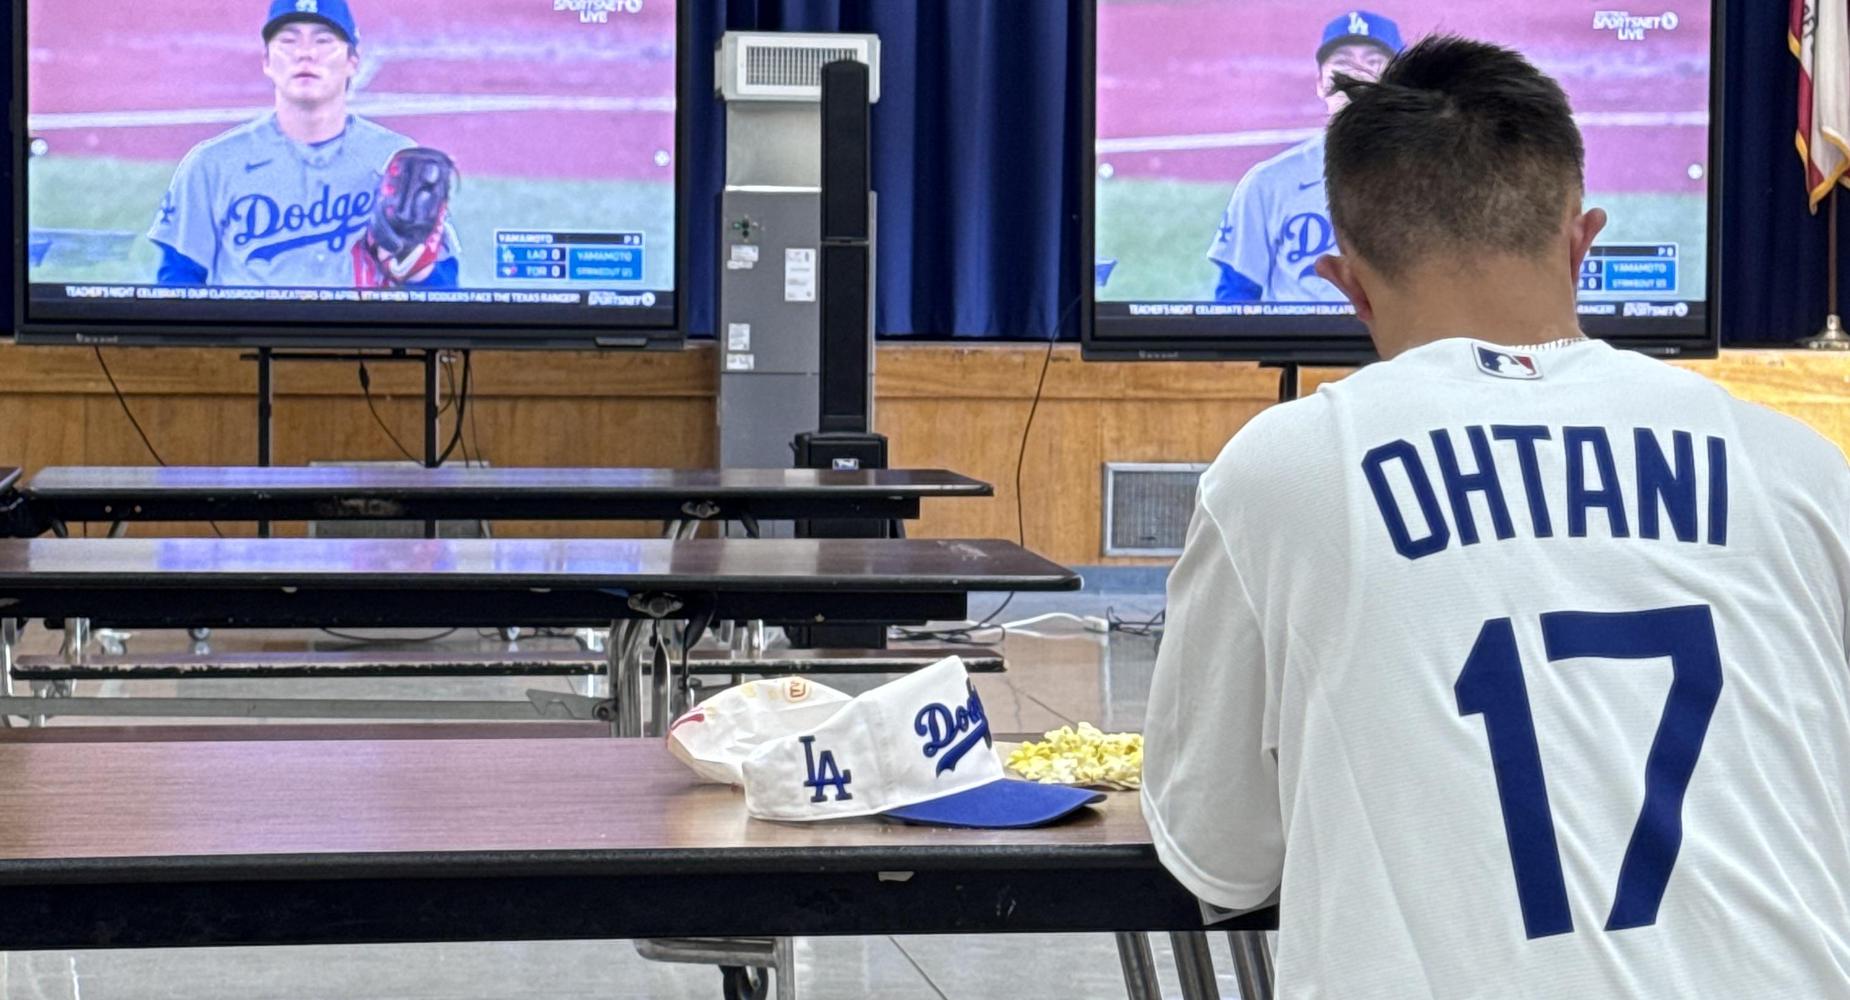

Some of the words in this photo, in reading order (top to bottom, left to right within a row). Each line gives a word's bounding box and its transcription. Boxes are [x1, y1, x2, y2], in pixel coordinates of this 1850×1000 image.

[579, 11, 608, 24] LIVE
[1617, 28, 1645, 41] LIVE
[498, 233, 554, 244] YAMAMOTO
[551, 248, 561, 261] 0
[576, 250, 633, 263] YAMAMOTO
[551, 265, 561, 278] 0
[1588, 260, 1597, 273] 0
[1612, 262, 1667, 274] YAMAMOTO
[1588, 277, 1597, 289] 0
[136, 287, 187, 300] CELEBRATE
[188, 288, 208, 300] OUR
[209, 288, 265, 301] CLASSROOM
[265, 289, 319, 301] EDUCATORS
[319, 290, 334, 301] ON
[335, 290, 360, 302] APRIL
[381, 290, 410, 302] WHEN
[410, 291, 427, 303] THE
[428, 291, 470, 303] DODGERS
[470, 292, 492, 304] FACE
[493, 292, 511, 304] THE
[511, 292, 540, 304] TEXAS
[1195, 304, 1242, 315] CELEBRATE
[1243, 304, 1262, 315] OUR
[1263, 304, 1316, 315] CLASSROOM
[1361, 424, 1728, 560] OHTANI
[798, 735, 853, 803] LA
[1454, 604, 1723, 940] 17
